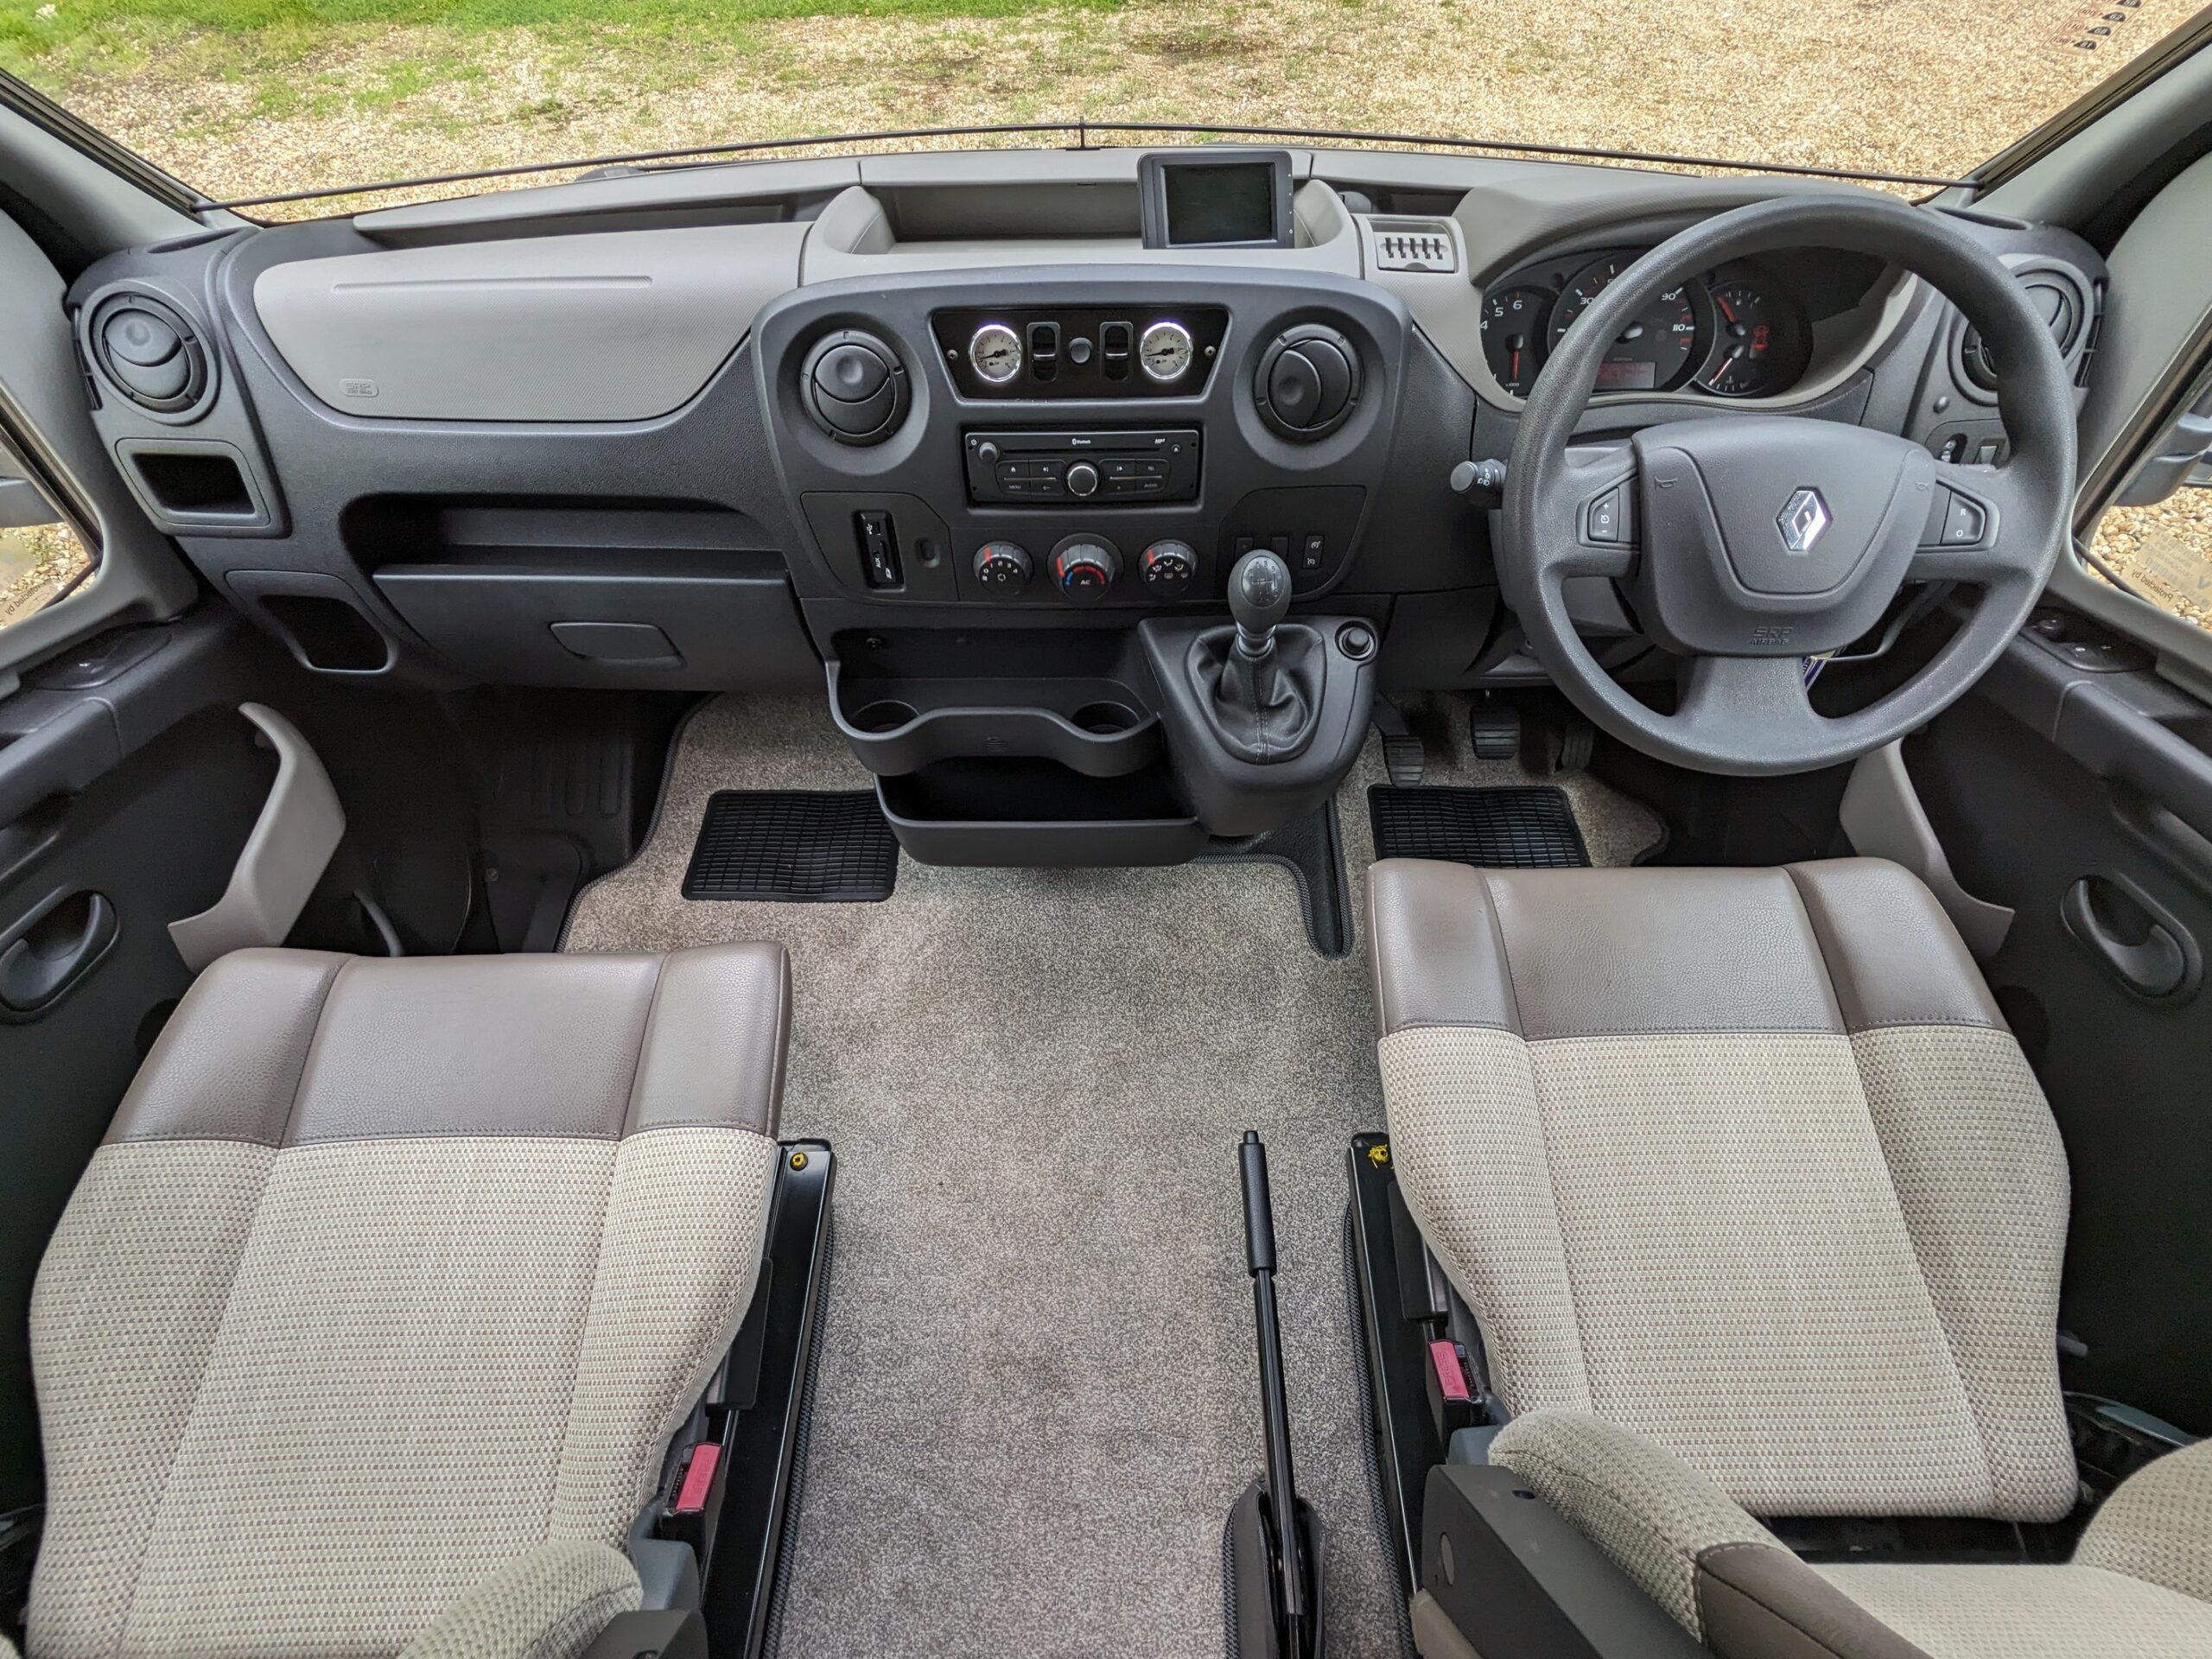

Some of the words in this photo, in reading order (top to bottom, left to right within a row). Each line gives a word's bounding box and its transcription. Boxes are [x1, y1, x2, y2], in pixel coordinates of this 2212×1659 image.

[1661, 292, 1676, 301] 90
[1512, 300, 1522, 310] 6
[1494, 307, 1504, 317] 5
[1479, 320, 1489, 330] 4
[1672, 323, 1686, 332] 110
